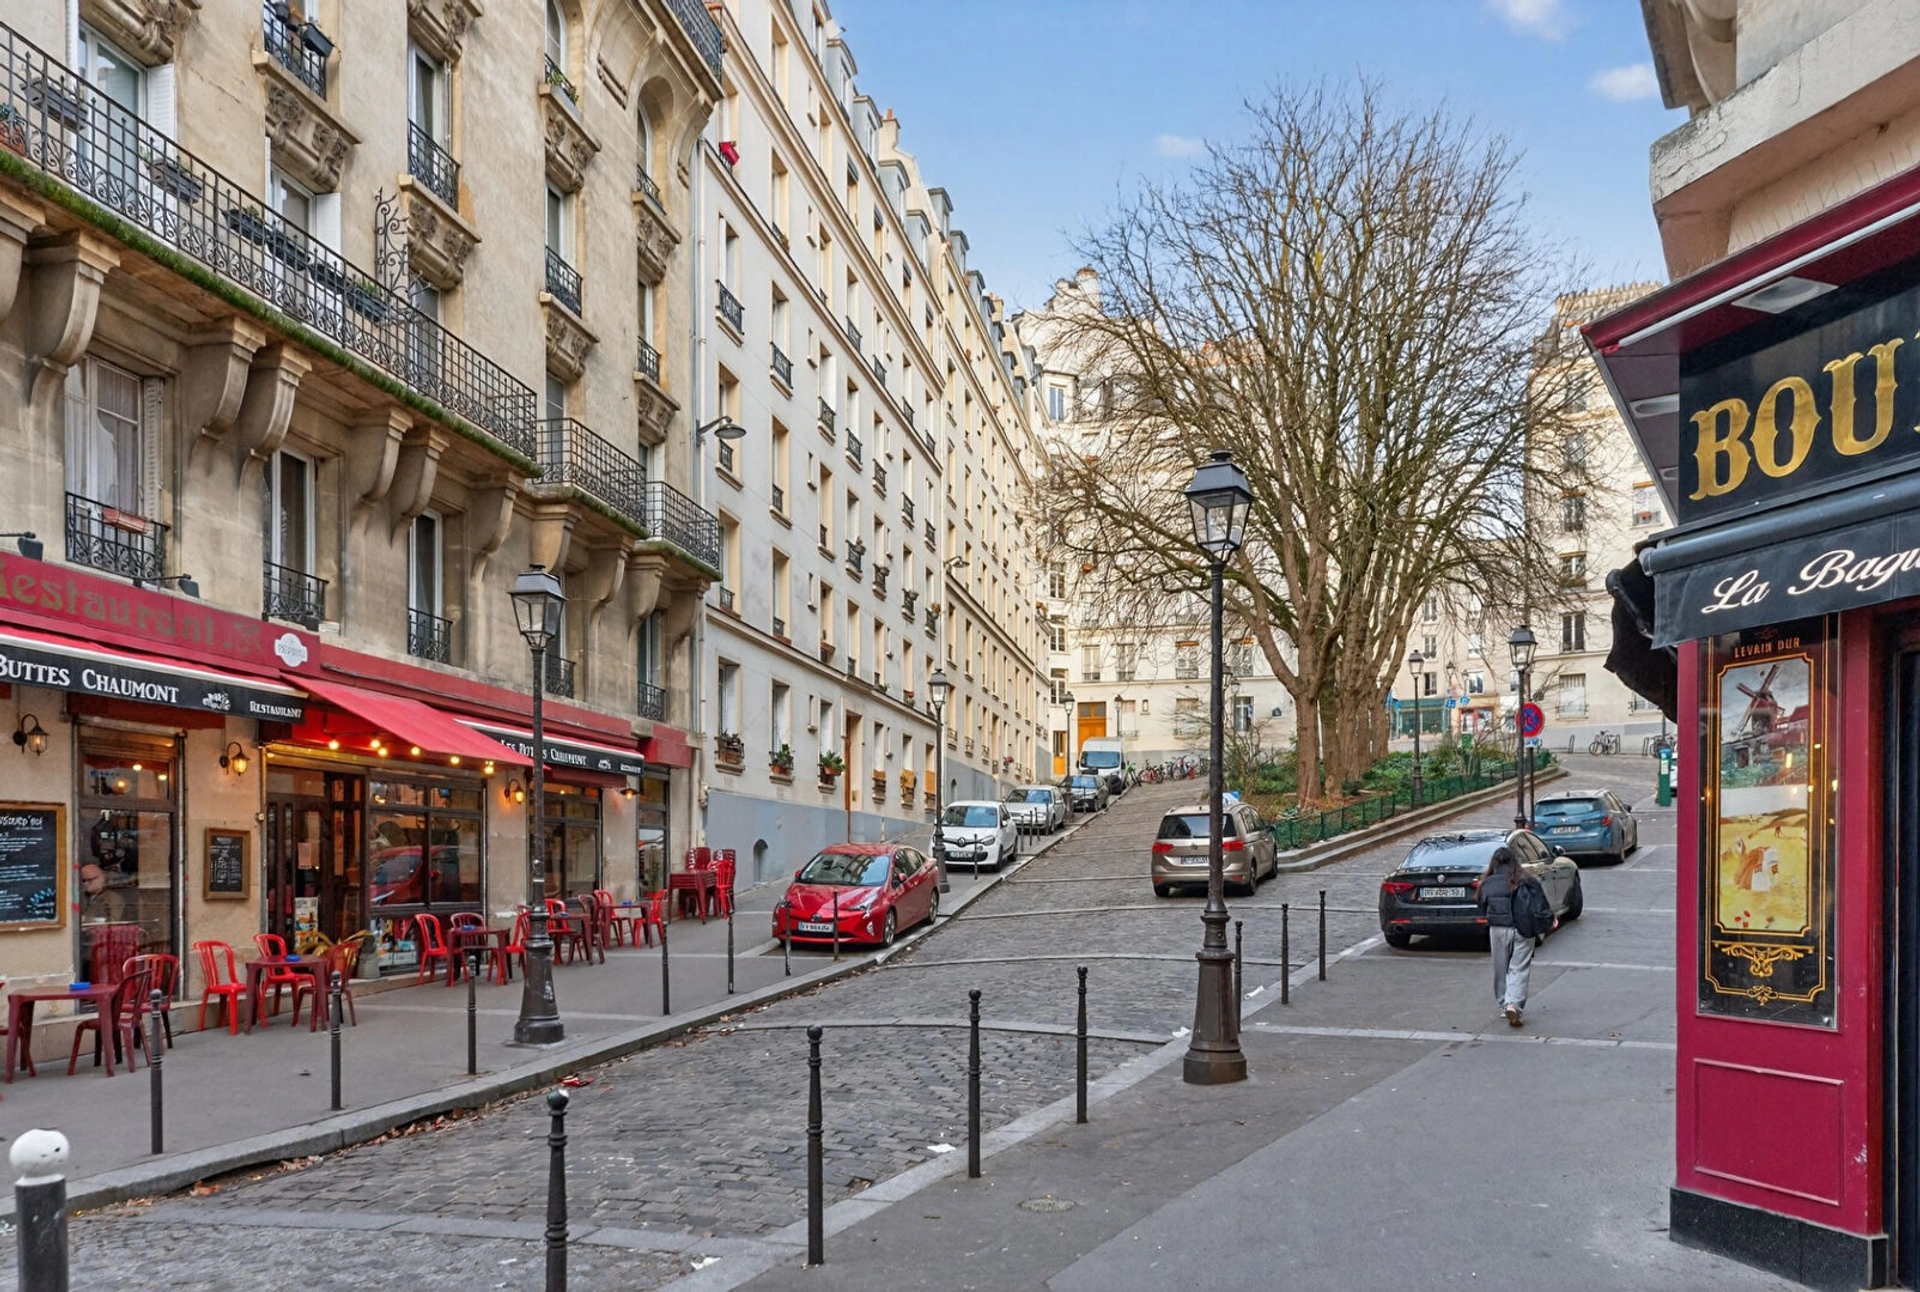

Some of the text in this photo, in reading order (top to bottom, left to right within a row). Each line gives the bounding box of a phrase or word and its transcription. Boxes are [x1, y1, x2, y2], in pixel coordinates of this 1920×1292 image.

[1689, 330, 1920, 501] BOU
[1701, 569, 1770, 614] La
[1734, 642, 1772, 659] LEVAIN
[0, 654, 179, 703] BUTTES CHAUMONT
[249, 700, 302, 718] RESTAURANT
